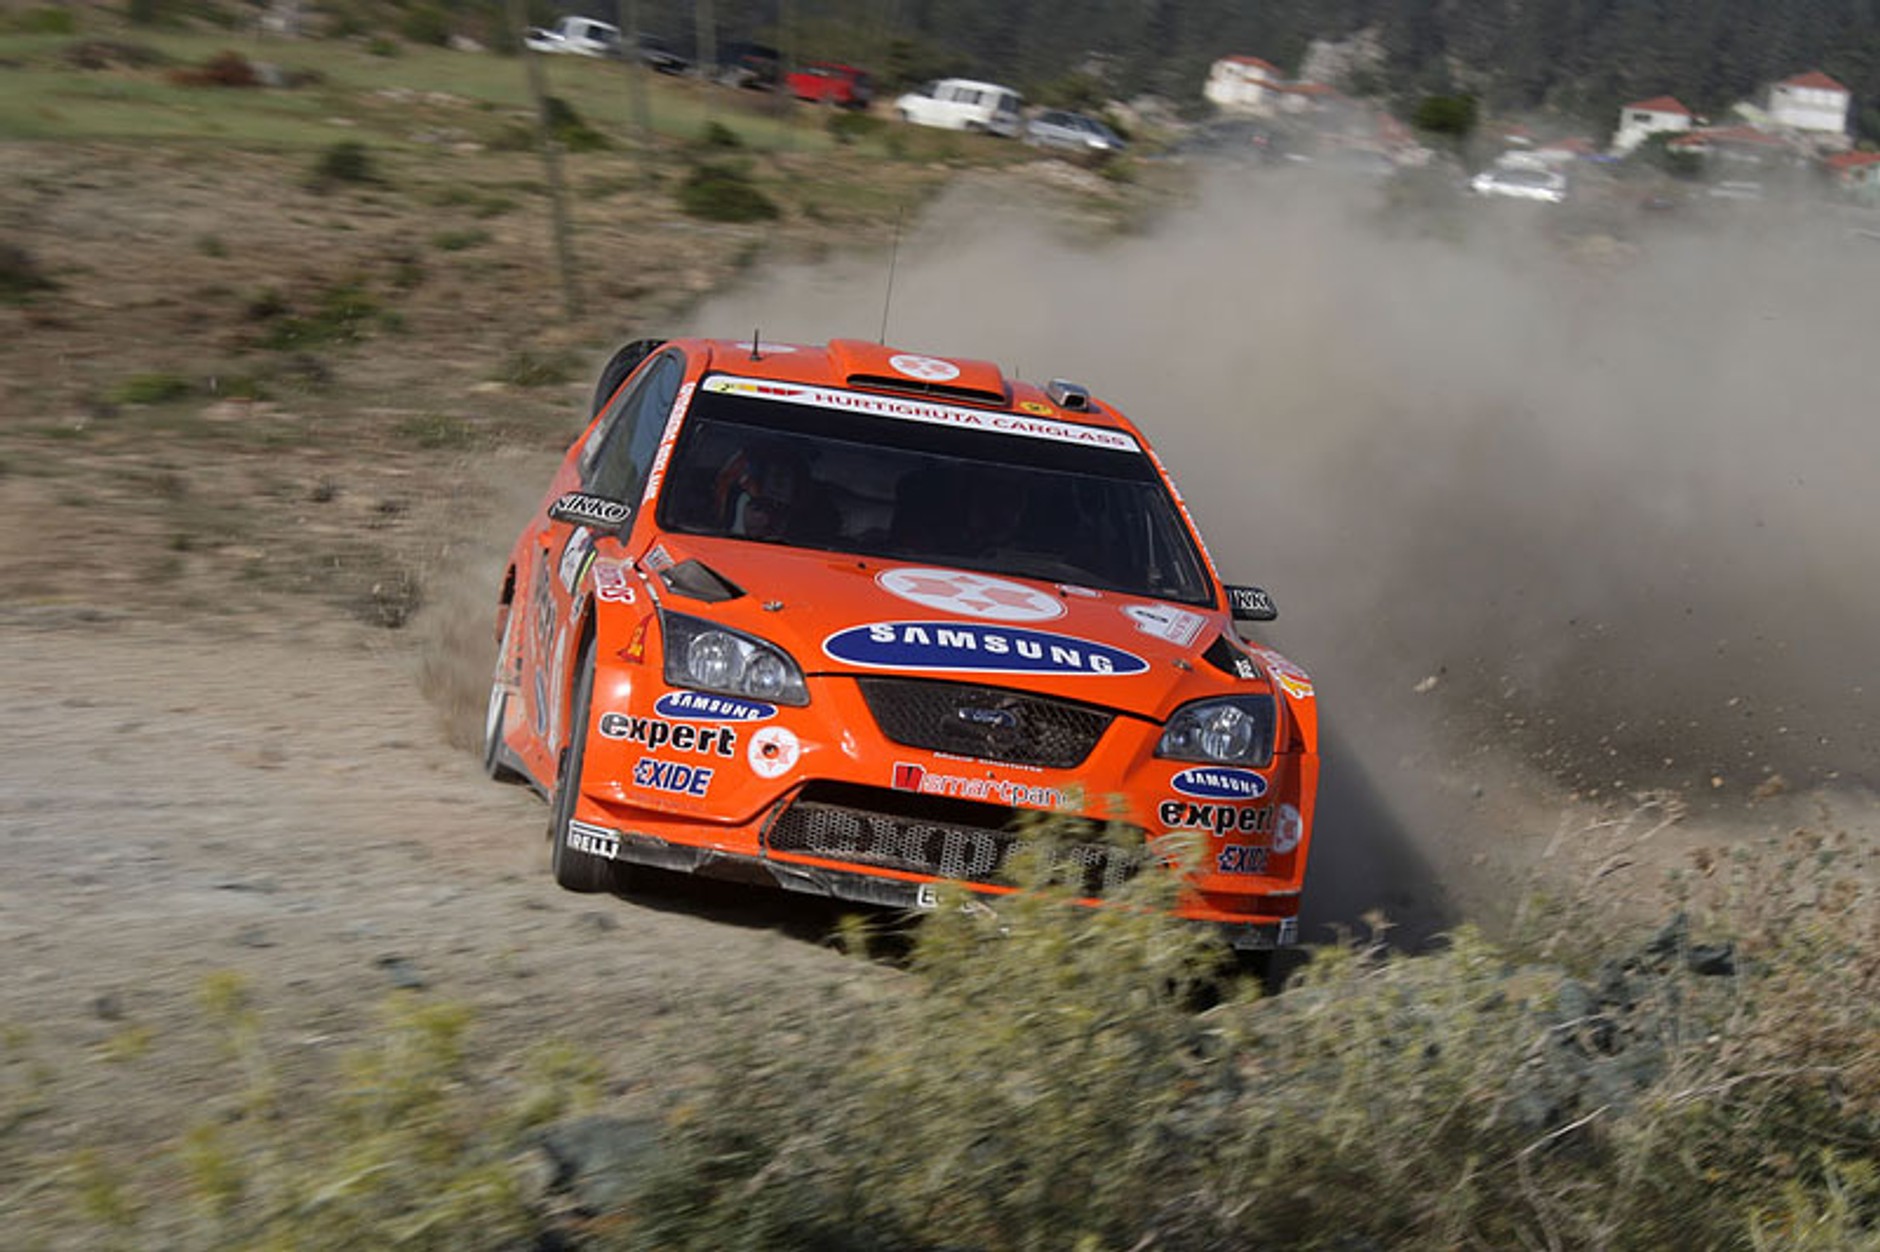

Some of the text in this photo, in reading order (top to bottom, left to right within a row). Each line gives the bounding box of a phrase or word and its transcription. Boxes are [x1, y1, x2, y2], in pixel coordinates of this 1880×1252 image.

[815, 394, 1126, 446] HURTIGRUTA CARGLASS
[869, 622, 1114, 673] SAMSUNG
[669, 692, 759, 720] SAMSUNG
[600, 712, 736, 757] expert
[633, 757, 713, 797] EXIDE
[923, 772, 1069, 808] smartpan
[1184, 771, 1260, 798] SAMSUNG
